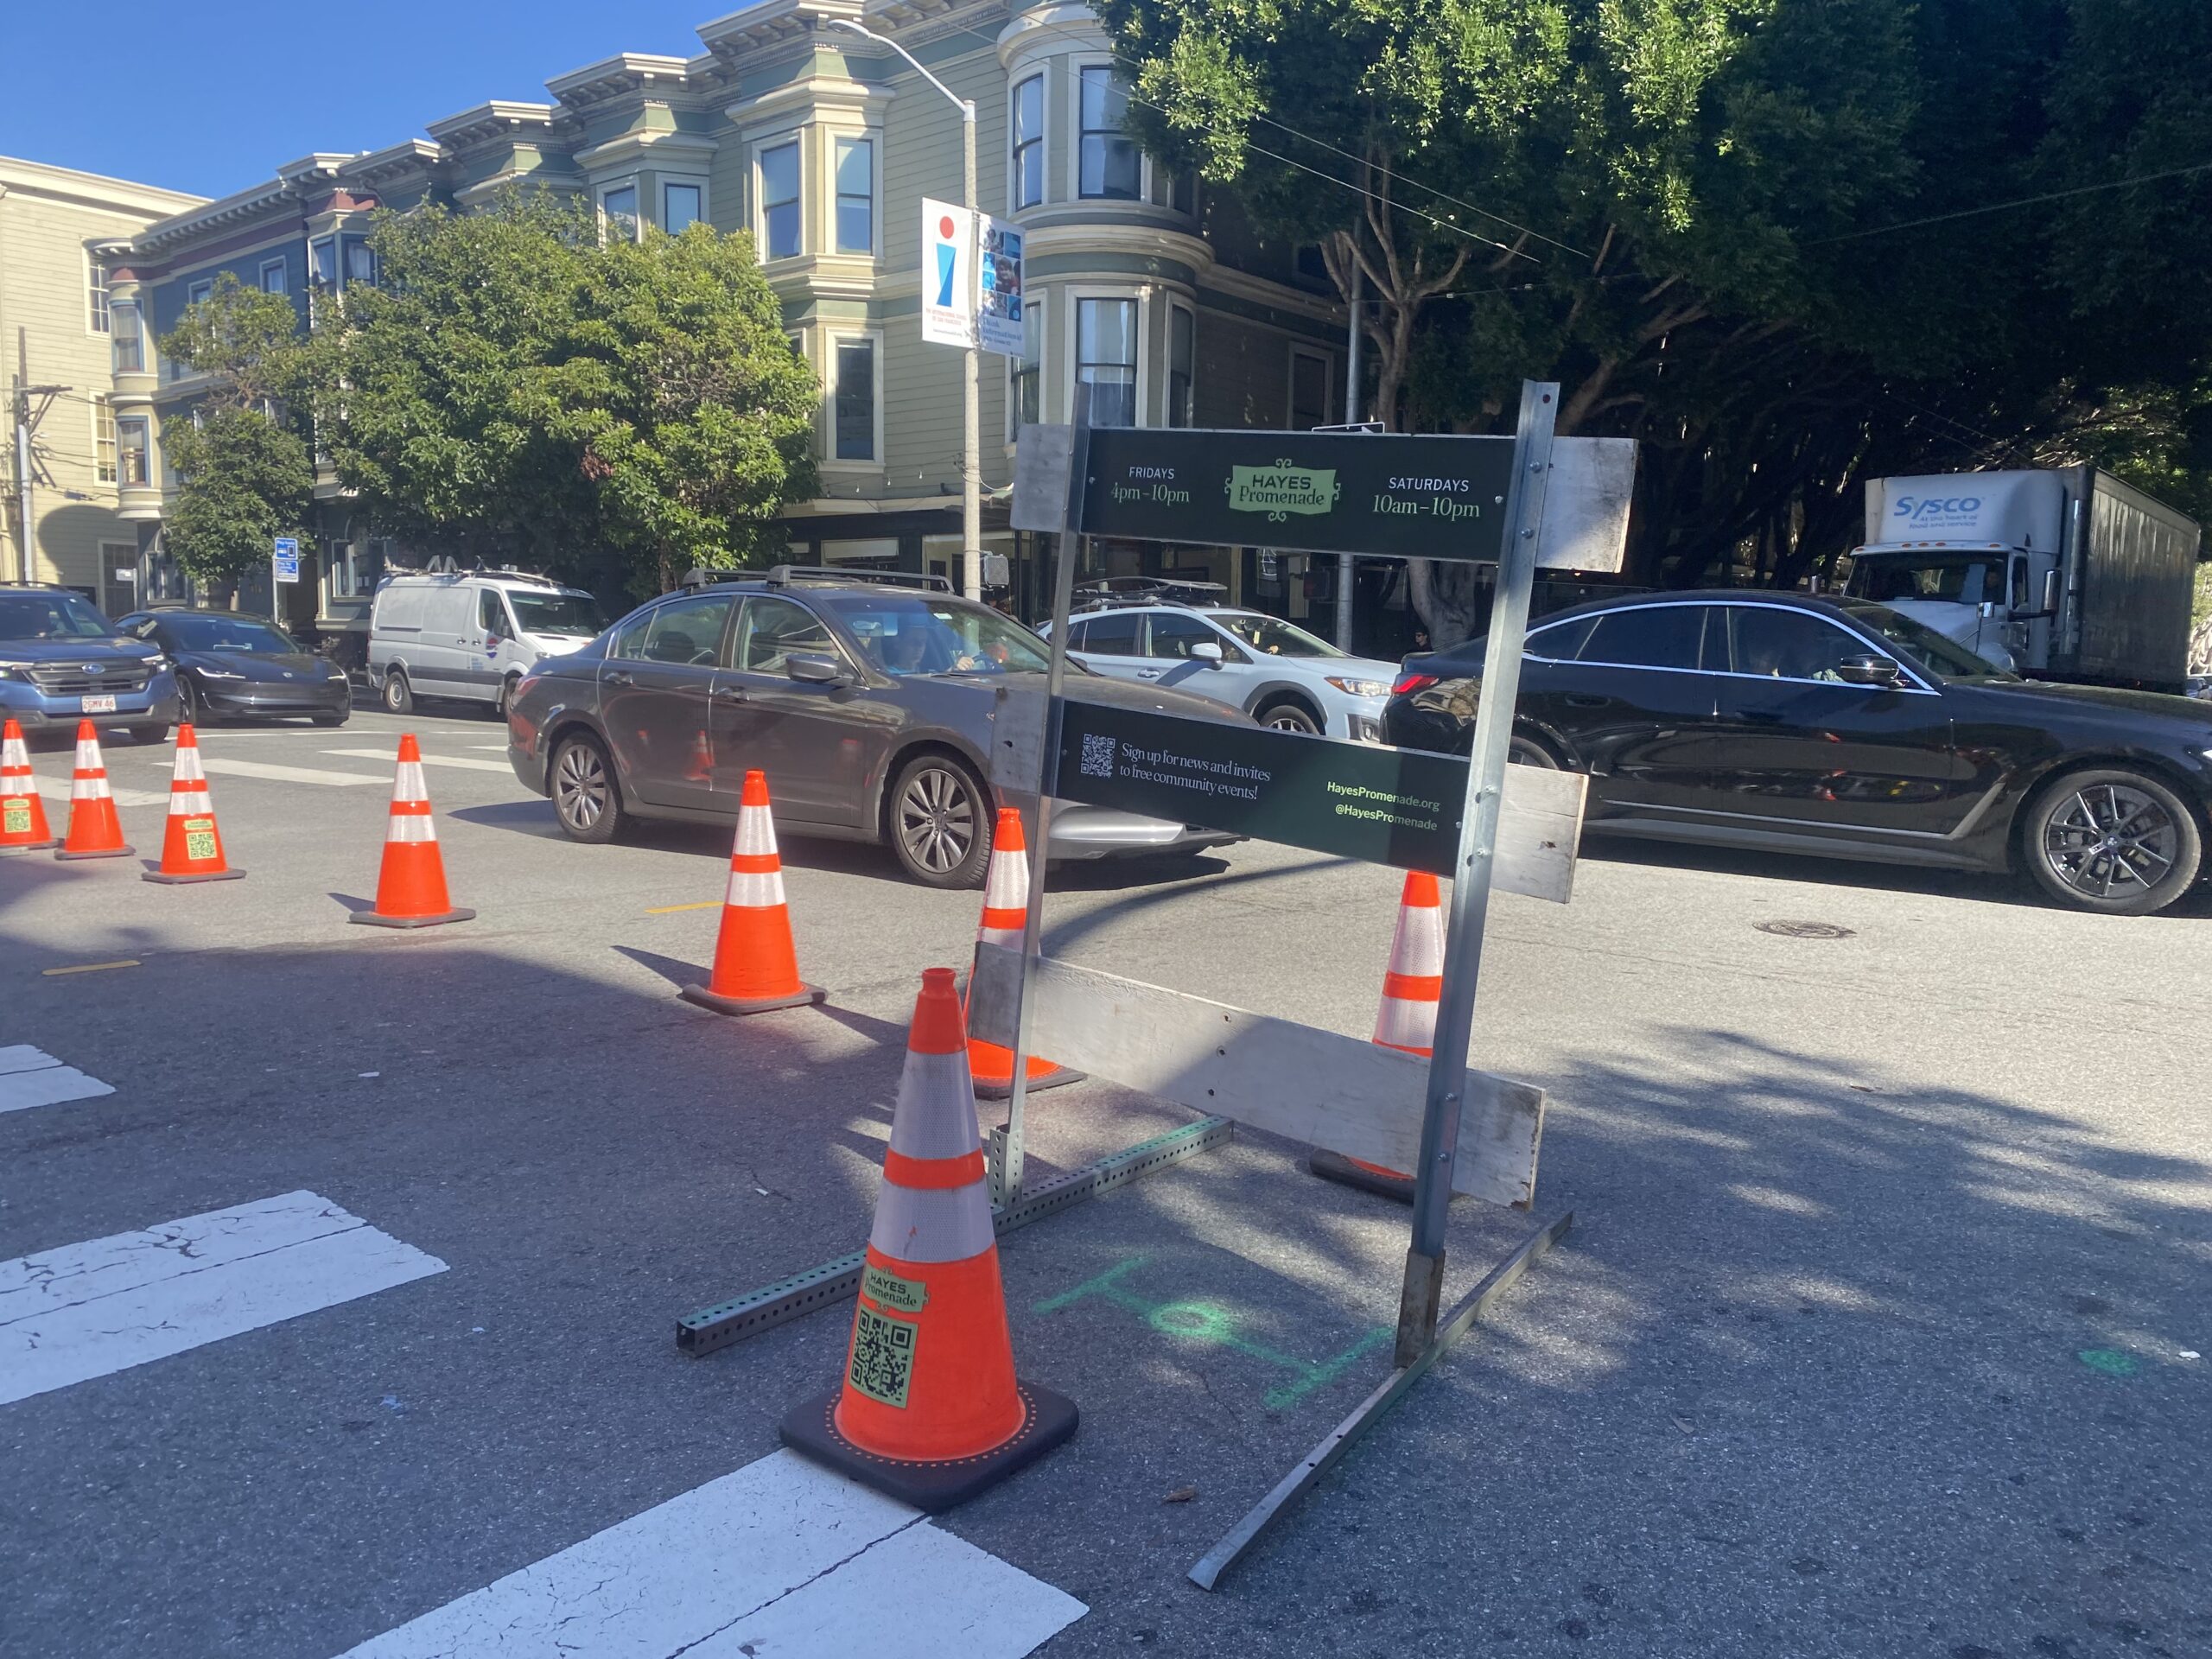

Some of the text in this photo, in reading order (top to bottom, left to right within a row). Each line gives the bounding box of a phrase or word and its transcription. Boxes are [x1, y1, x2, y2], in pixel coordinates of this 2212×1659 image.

[1128, 467, 1175, 480] FRIDAYS
[1252, 474, 1312, 490] HAYES
[1388, 477, 1469, 492] SATURDAYS
[1239, 485, 1325, 505] Promenade
[1122, 742, 1271, 782] Sign up for news and invites
[1120, 764, 1258, 800] to free community events!
[1326, 781, 1440, 812] HayesPromenade.org
[1335, 804, 1438, 830] @HayesPromenade
[864, 1278, 917, 1306] Promenade
[870, 1272, 906, 1294] HAYES
